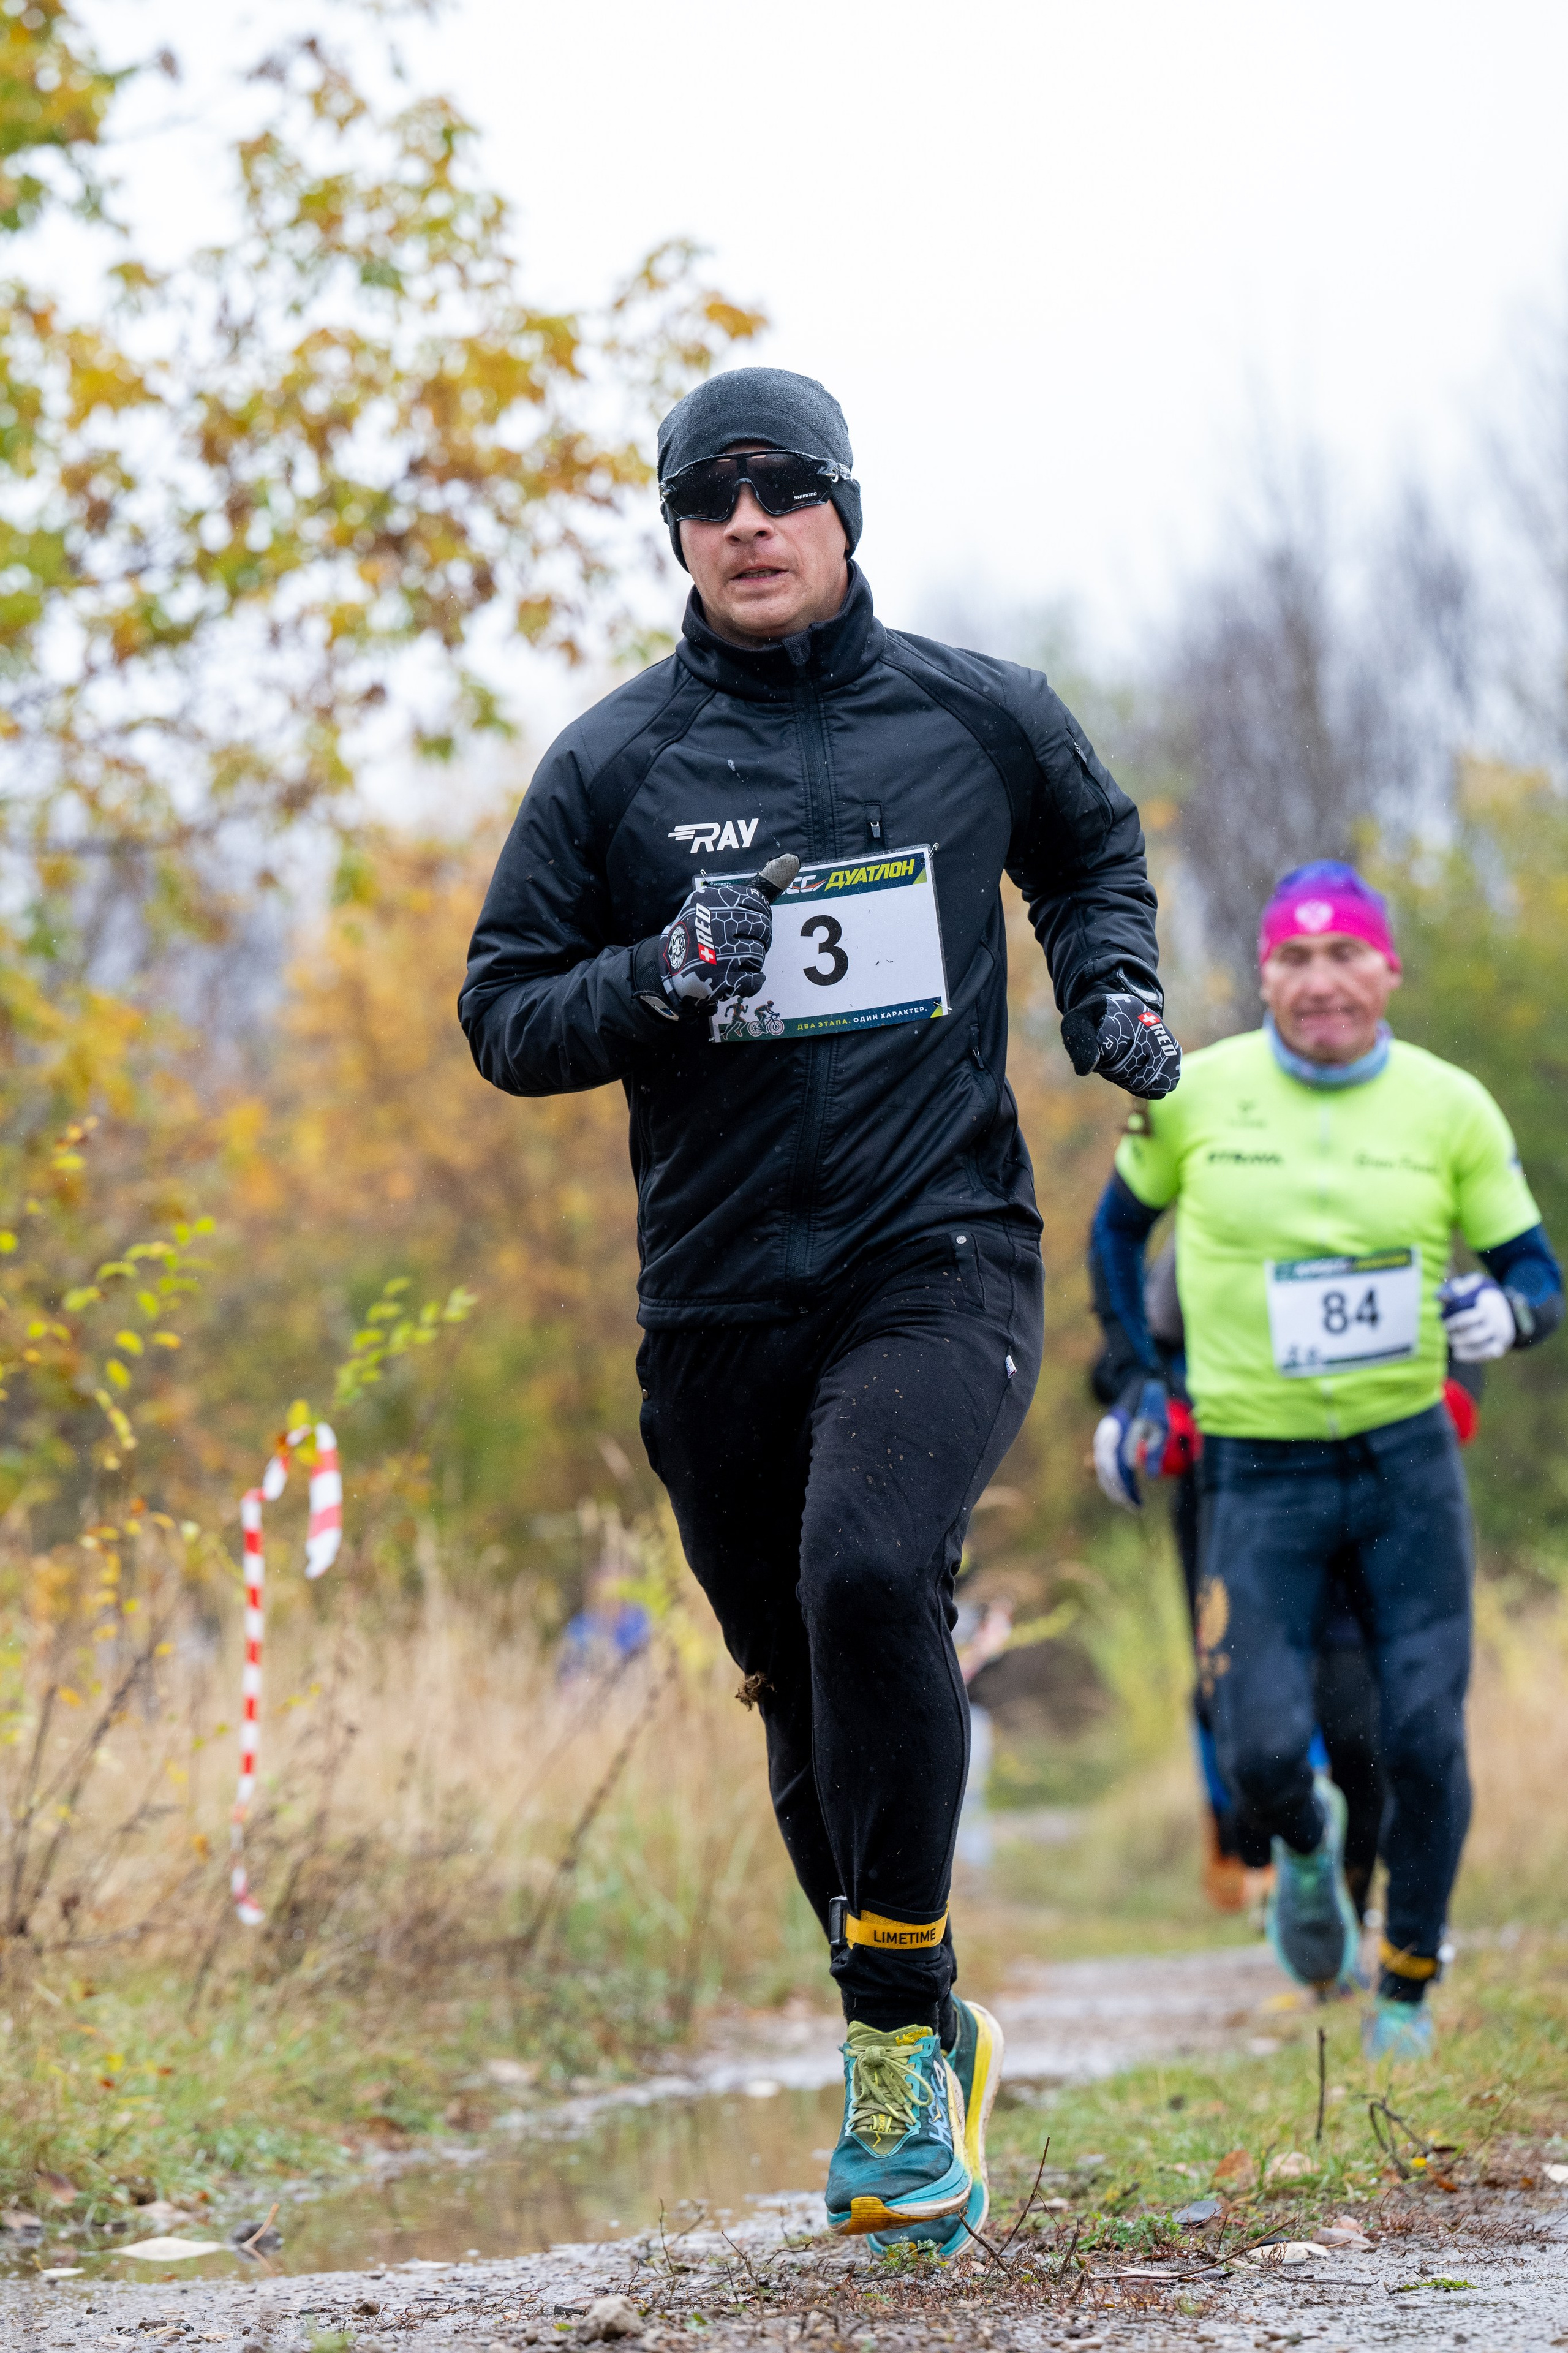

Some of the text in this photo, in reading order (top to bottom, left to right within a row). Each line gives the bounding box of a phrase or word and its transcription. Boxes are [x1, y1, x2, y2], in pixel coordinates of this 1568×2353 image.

[793, 491, 817, 500] SHIMANO
[824, 859, 915, 892] ДУАТЛОН
[695, 902, 715, 950] RED
[800, 915, 849, 986] 3
[818, 1019, 851, 1028] ЭТАПА.
[853, 1014, 878, 1023] ОДИН
[881, 1007, 928, 1018] ХАРАКТЕР.
[1149, 1023, 1178, 1057] RED
[1322, 1288, 1379, 1334] 84
[873, 1928, 937, 1944] LIMETIME
